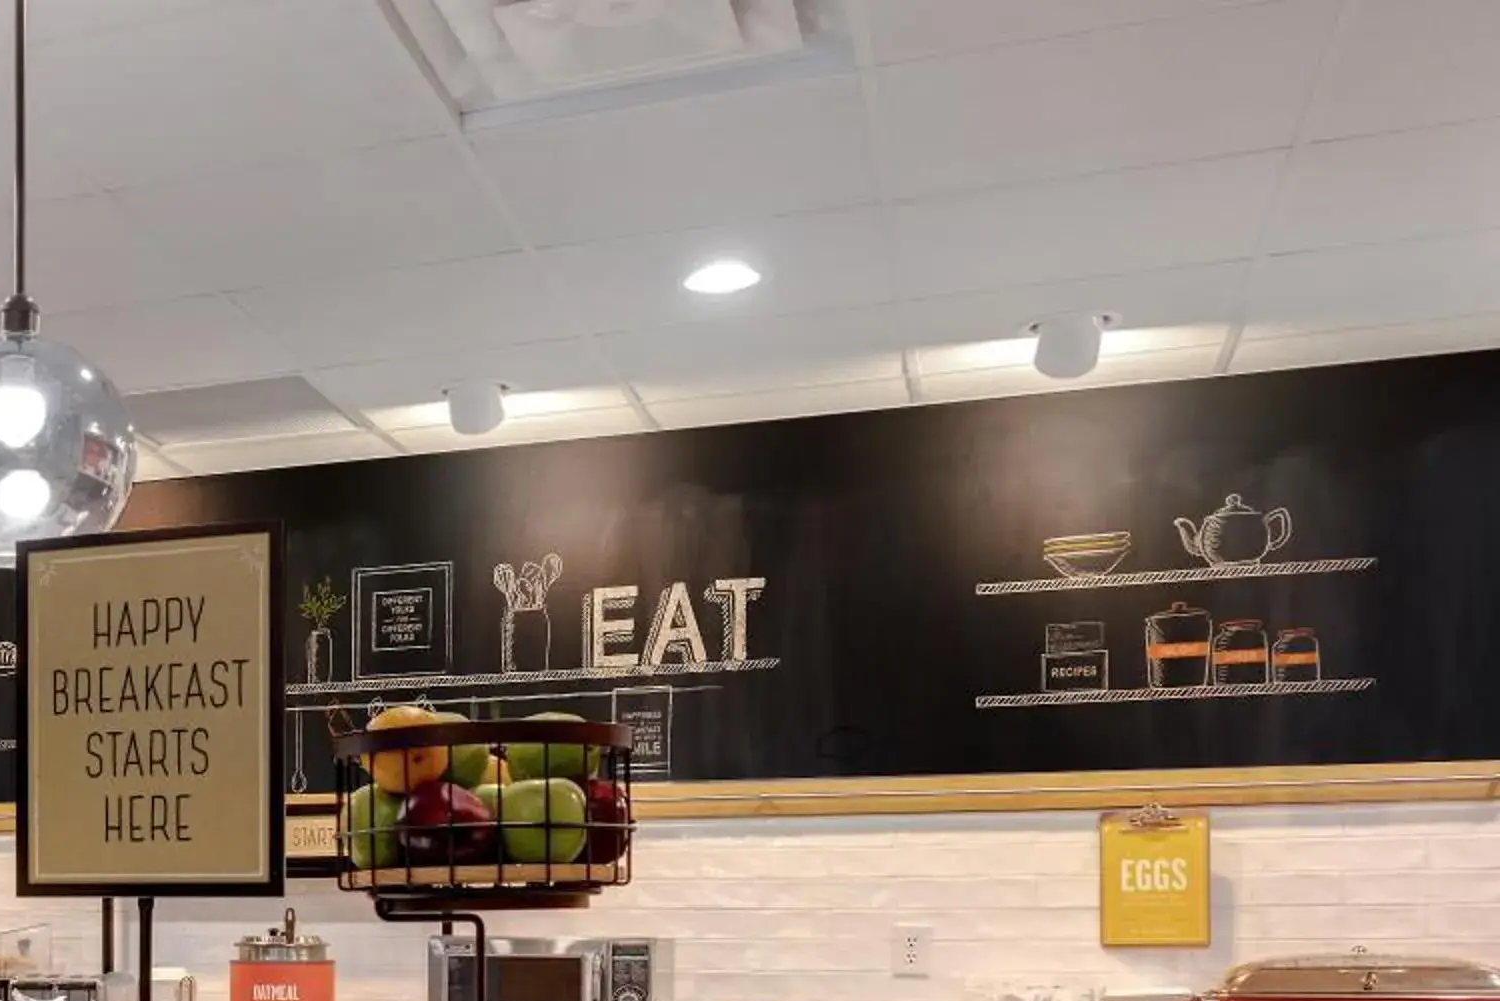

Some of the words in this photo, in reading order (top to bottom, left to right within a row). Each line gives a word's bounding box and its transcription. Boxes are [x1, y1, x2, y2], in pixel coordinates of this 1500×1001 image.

[93, 596, 205, 649] HAPPY
[583, 577, 767, 668] EAT
[52, 659, 250, 716] BREAKFAST
[1051, 665, 1097, 678] RECIPES
[85, 727, 210, 779] STARTS
[632, 741, 661, 756] MILE
[104, 794, 193, 843] HERE
[1120, 857, 1189, 893] EGGS
[252, 983, 300, 1001] OATMEAL
